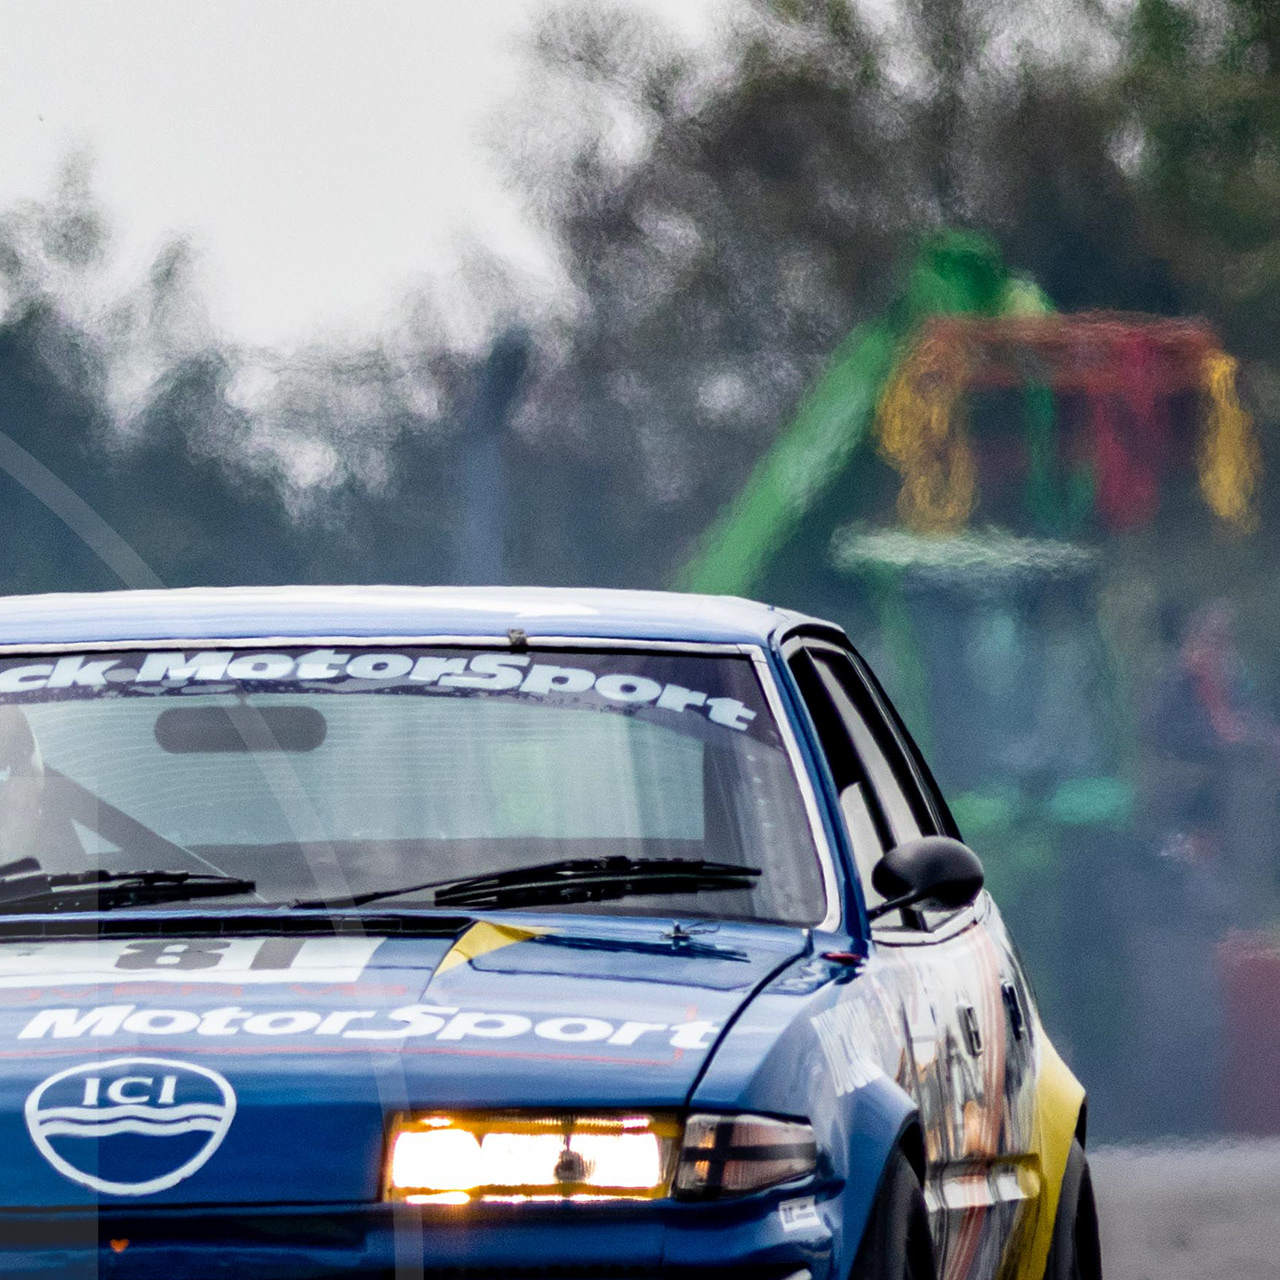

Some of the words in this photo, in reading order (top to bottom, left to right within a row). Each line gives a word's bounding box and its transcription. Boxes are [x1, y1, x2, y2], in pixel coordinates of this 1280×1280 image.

[134, 648, 757, 732] MotorSport
[113, 938, 303, 972] 81
[17, 1002, 727, 1051] MotorSport
[83, 1074, 178, 1107] ICI
